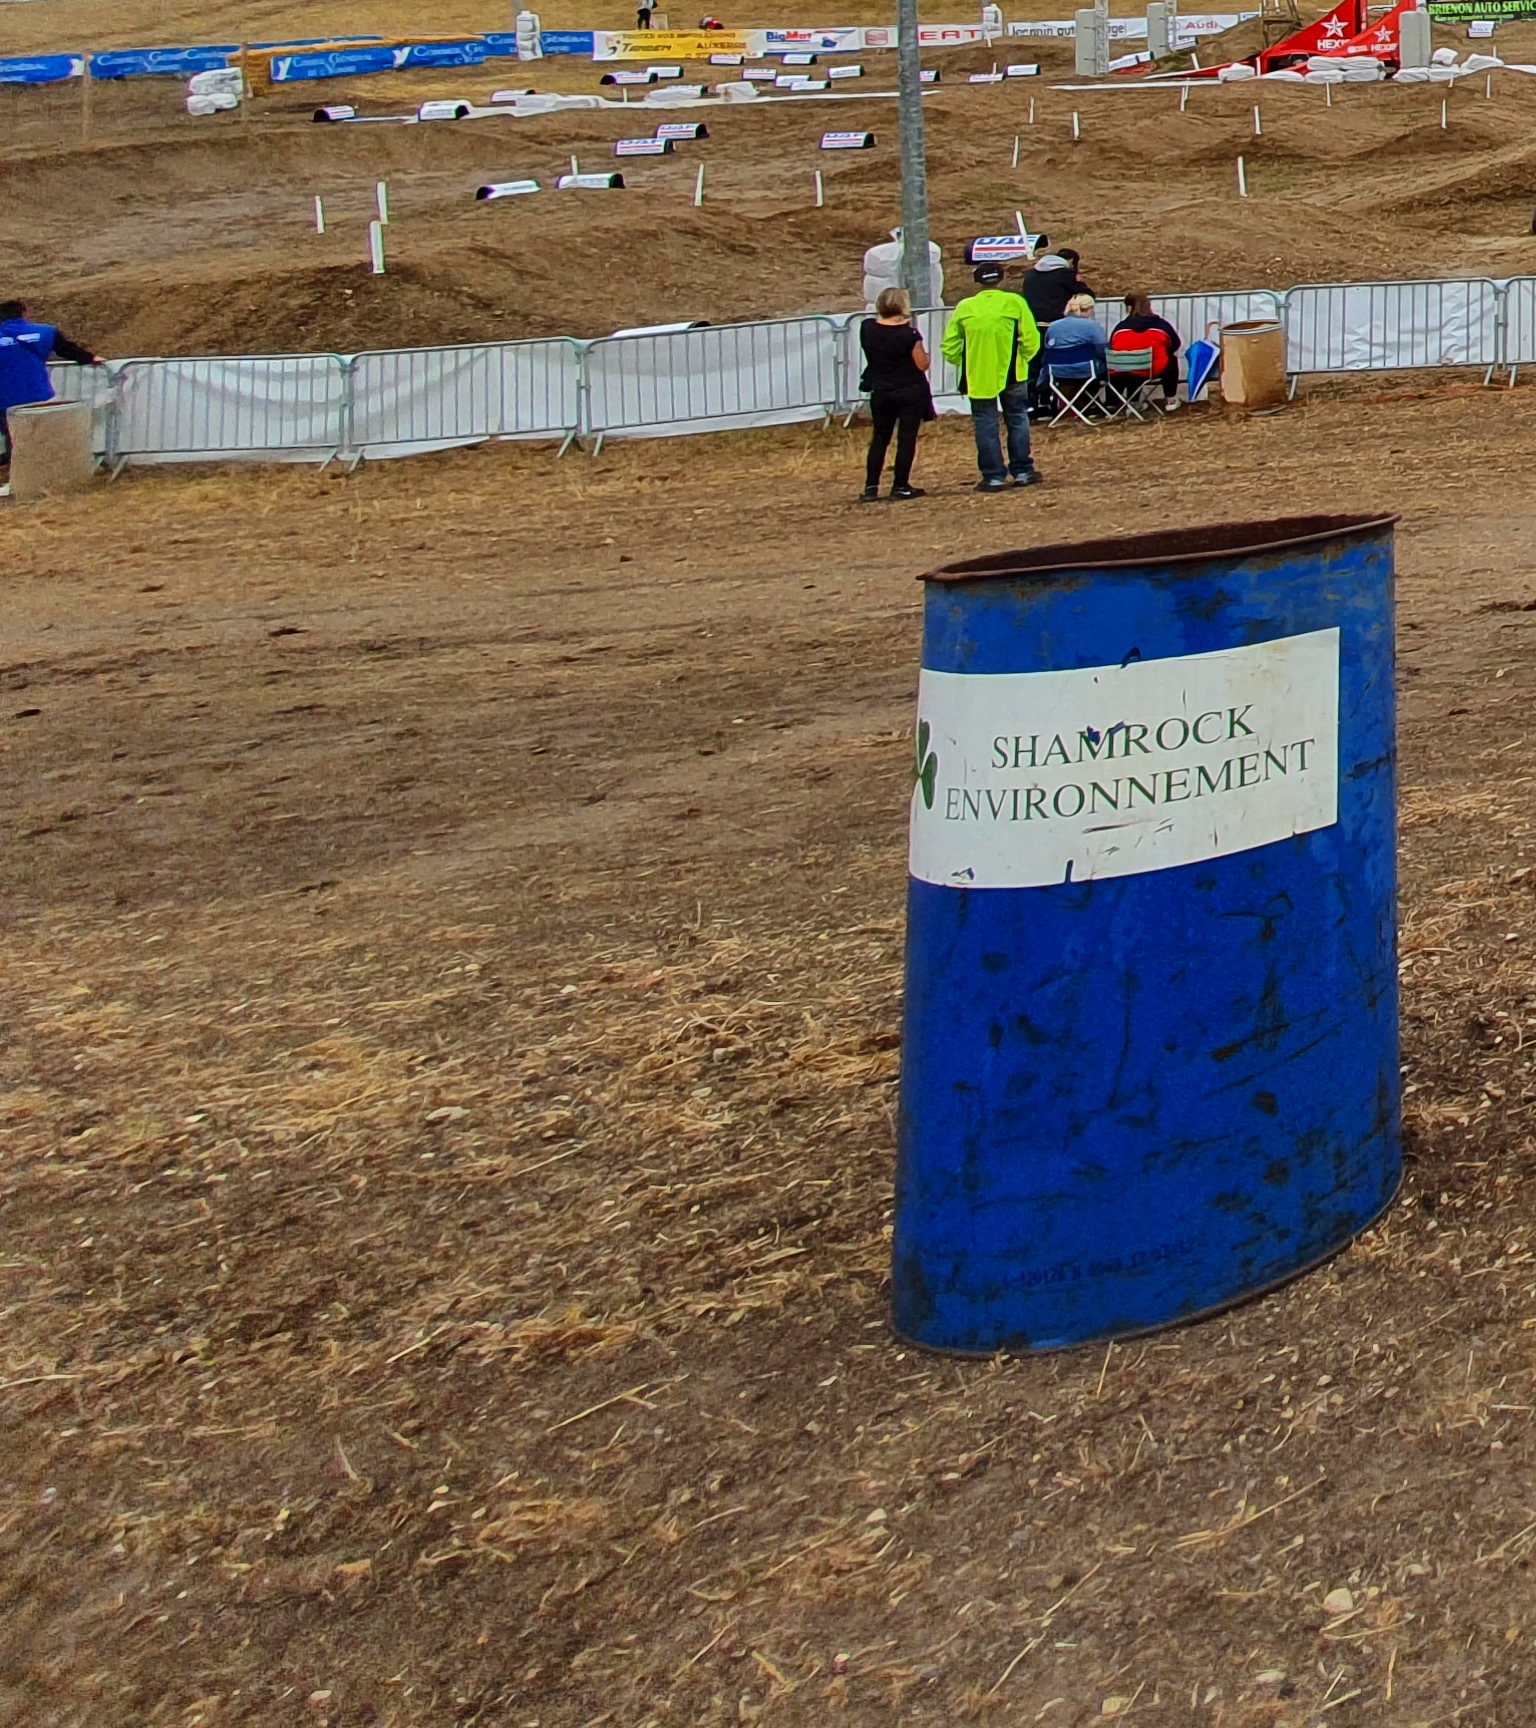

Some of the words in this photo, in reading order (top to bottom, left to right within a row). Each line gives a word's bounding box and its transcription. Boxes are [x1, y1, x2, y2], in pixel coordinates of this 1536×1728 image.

[1428, 2, 1473, 15] BRIENON
[1474, 2, 1501, 14] AUTO
[1185, 21, 1219, 30] Audi
[767, 31, 812, 43] BigMat
[920, 29, 984, 40] EAT
[991, 703, 1255, 770] SHAMROCK
[944, 738, 1316, 821] ENVIRONNEMENT
